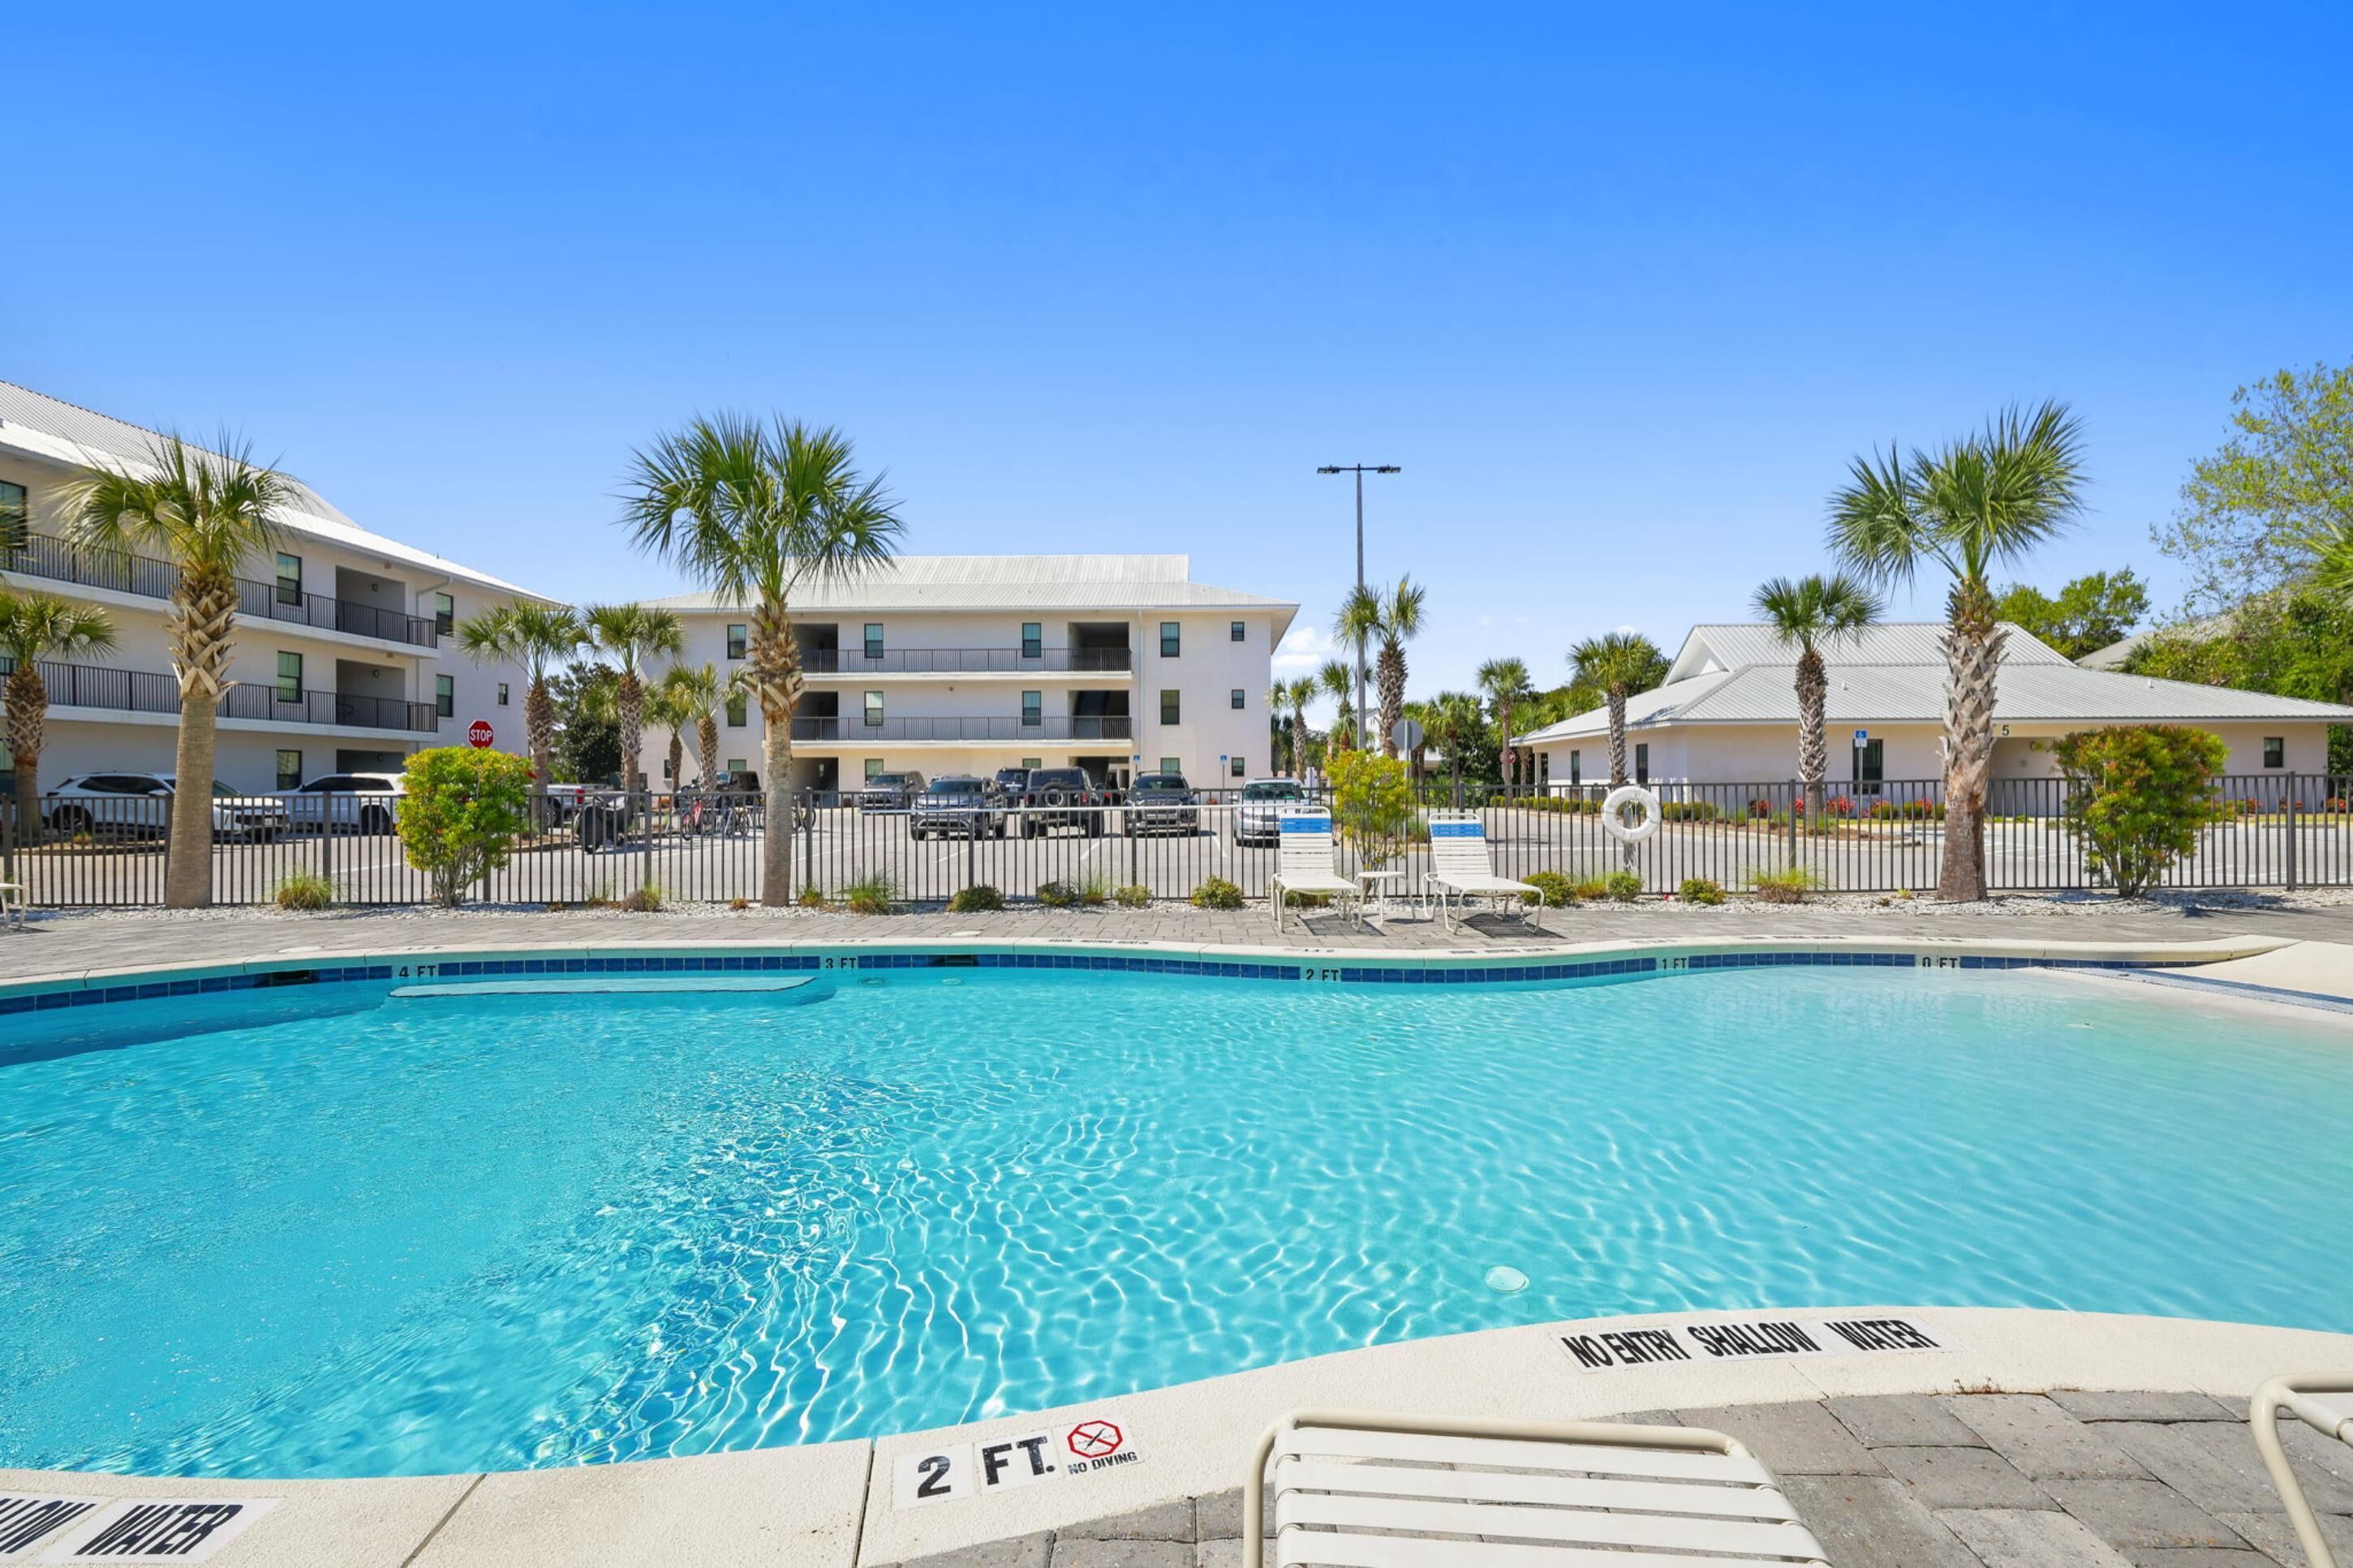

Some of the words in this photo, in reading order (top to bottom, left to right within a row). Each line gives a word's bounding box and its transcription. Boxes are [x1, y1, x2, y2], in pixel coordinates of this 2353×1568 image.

[470, 728, 493, 741] STOP
[2002, 724, 2010, 737] 5
[825, 957, 834, 969] 3
[841, 957, 857, 969] FT
[1662, 958, 1667, 969] 1
[1673, 957, 1688, 969] FT
[1939, 957, 1958, 969] FT
[398, 965, 409, 977] 4
[417, 965, 437, 977] FT
[1306, 969, 1314, 981] 2
[1322, 969, 1339, 982] FT
[1560, 1335, 1613, 1368] NO
[1600, 1329, 1693, 1365] ENTRY
[1686, 1321, 1822, 1358] SHALLOW
[1823, 1319, 1942, 1351] WATER
[917, 1456, 951, 1499] 2
[981, 1435, 1056, 1486] FT.
[1067, 1462, 1088, 1475] NO
[1092, 1450, 1138, 1471] DIVING
[73, 1504, 243, 1556] WATER
